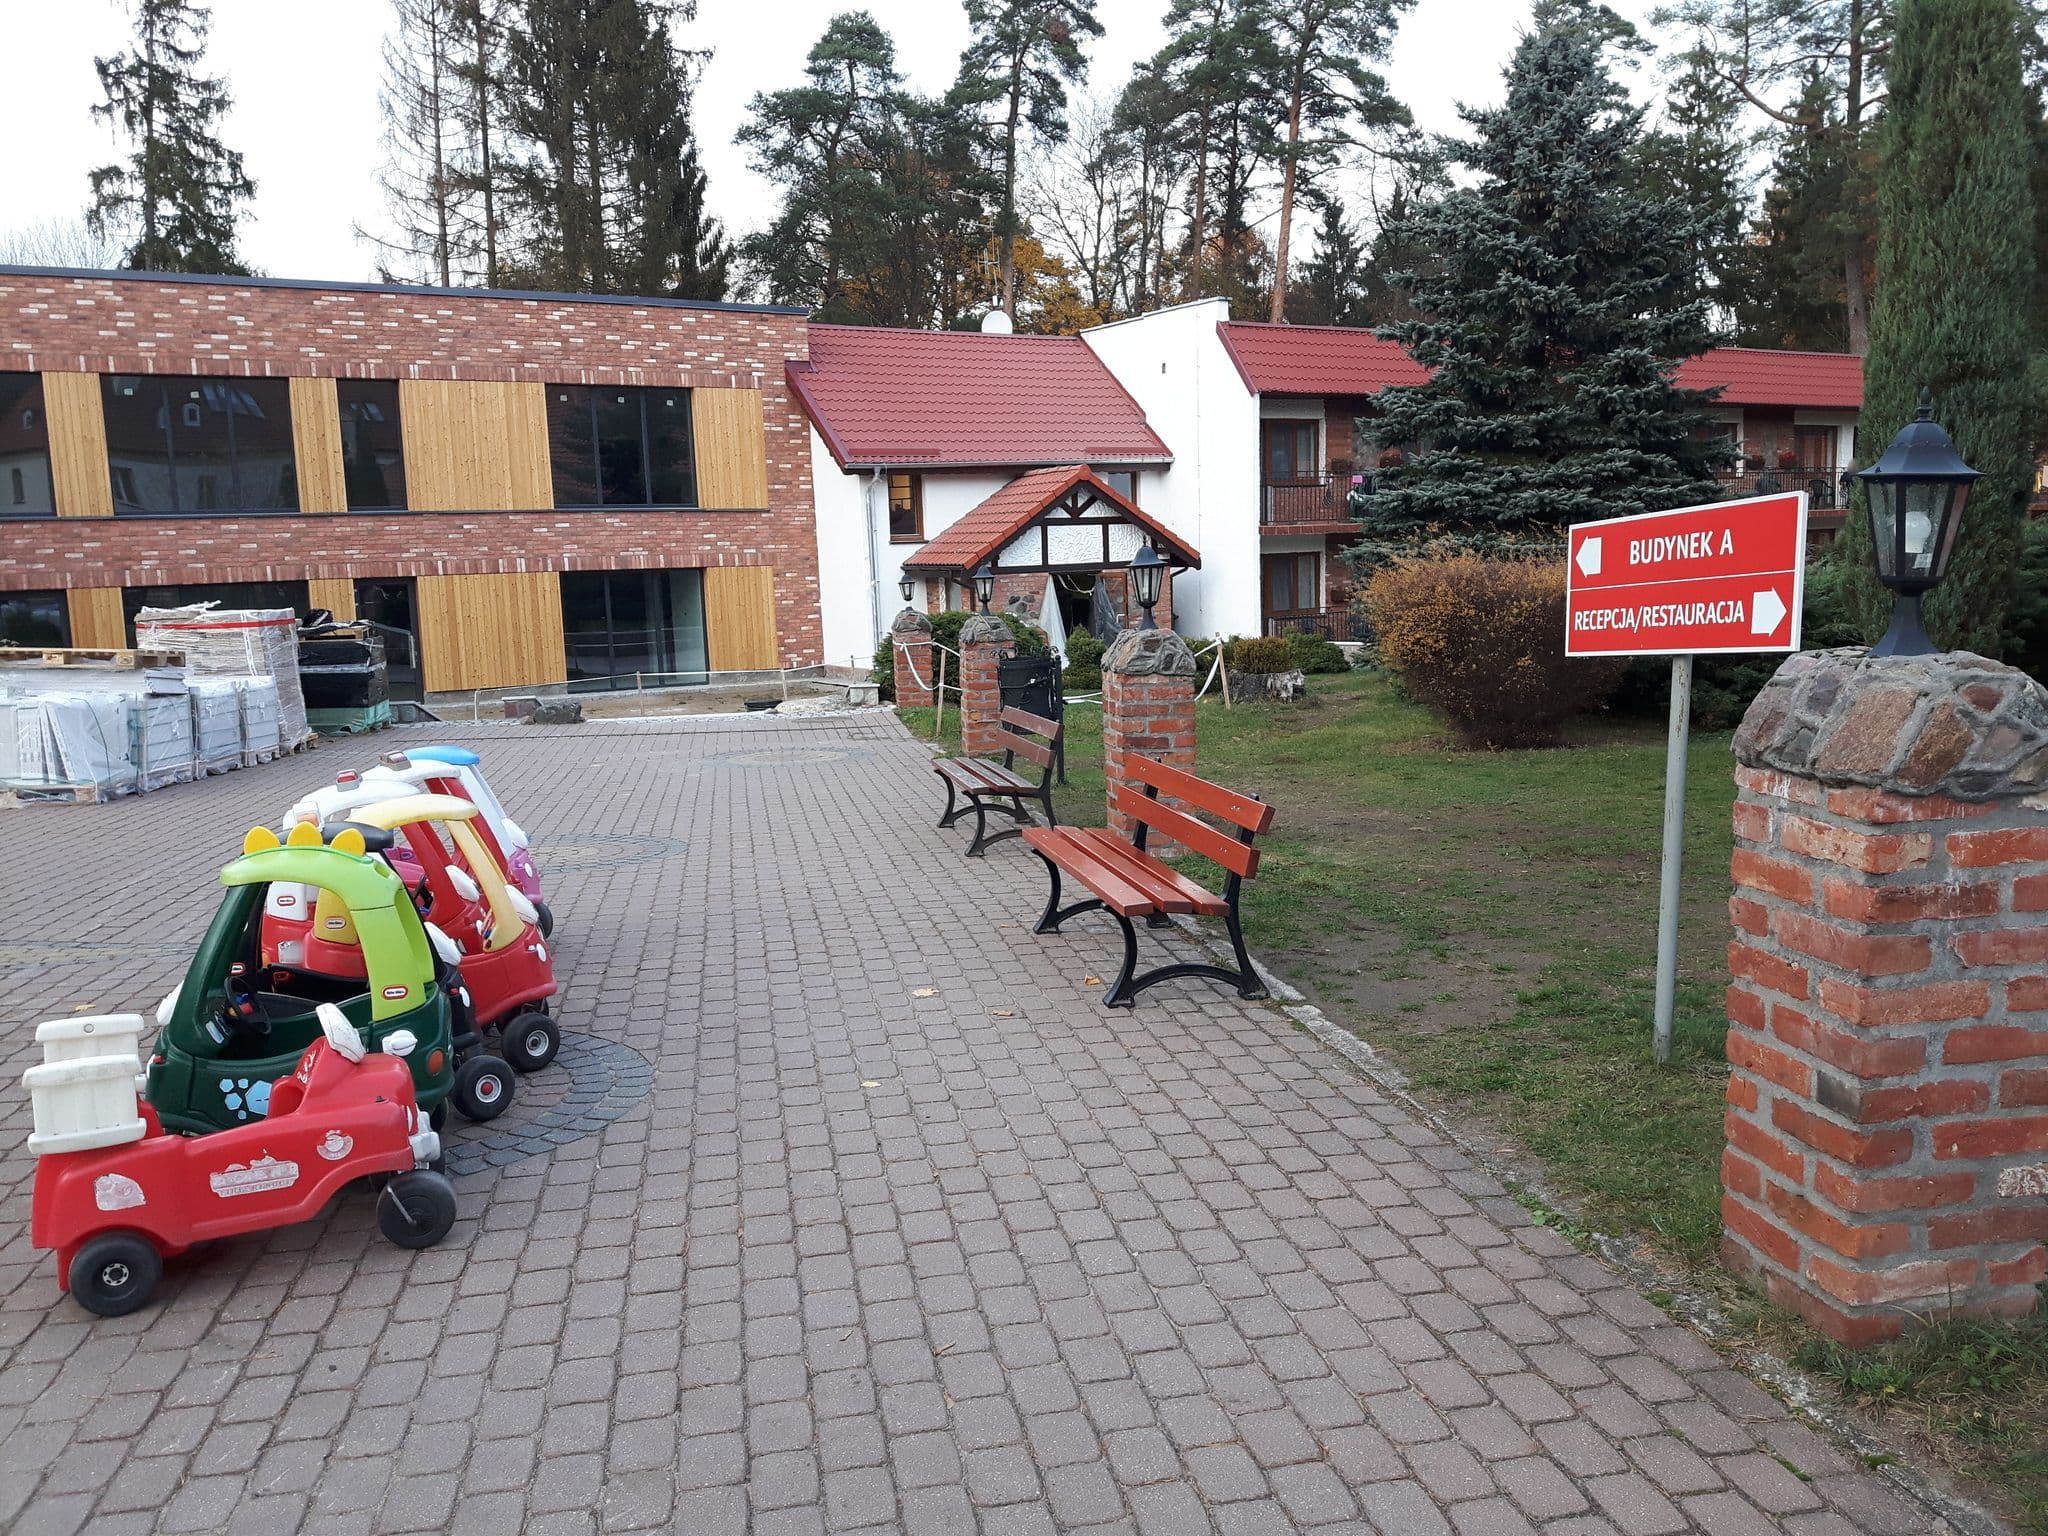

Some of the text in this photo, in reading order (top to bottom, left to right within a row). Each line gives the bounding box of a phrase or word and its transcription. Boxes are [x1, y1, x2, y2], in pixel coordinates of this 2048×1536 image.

[1630, 529, 1733, 564] BUDYNEK A
[1575, 601, 1744, 633] RECEPCJA/RESTAURACJA
